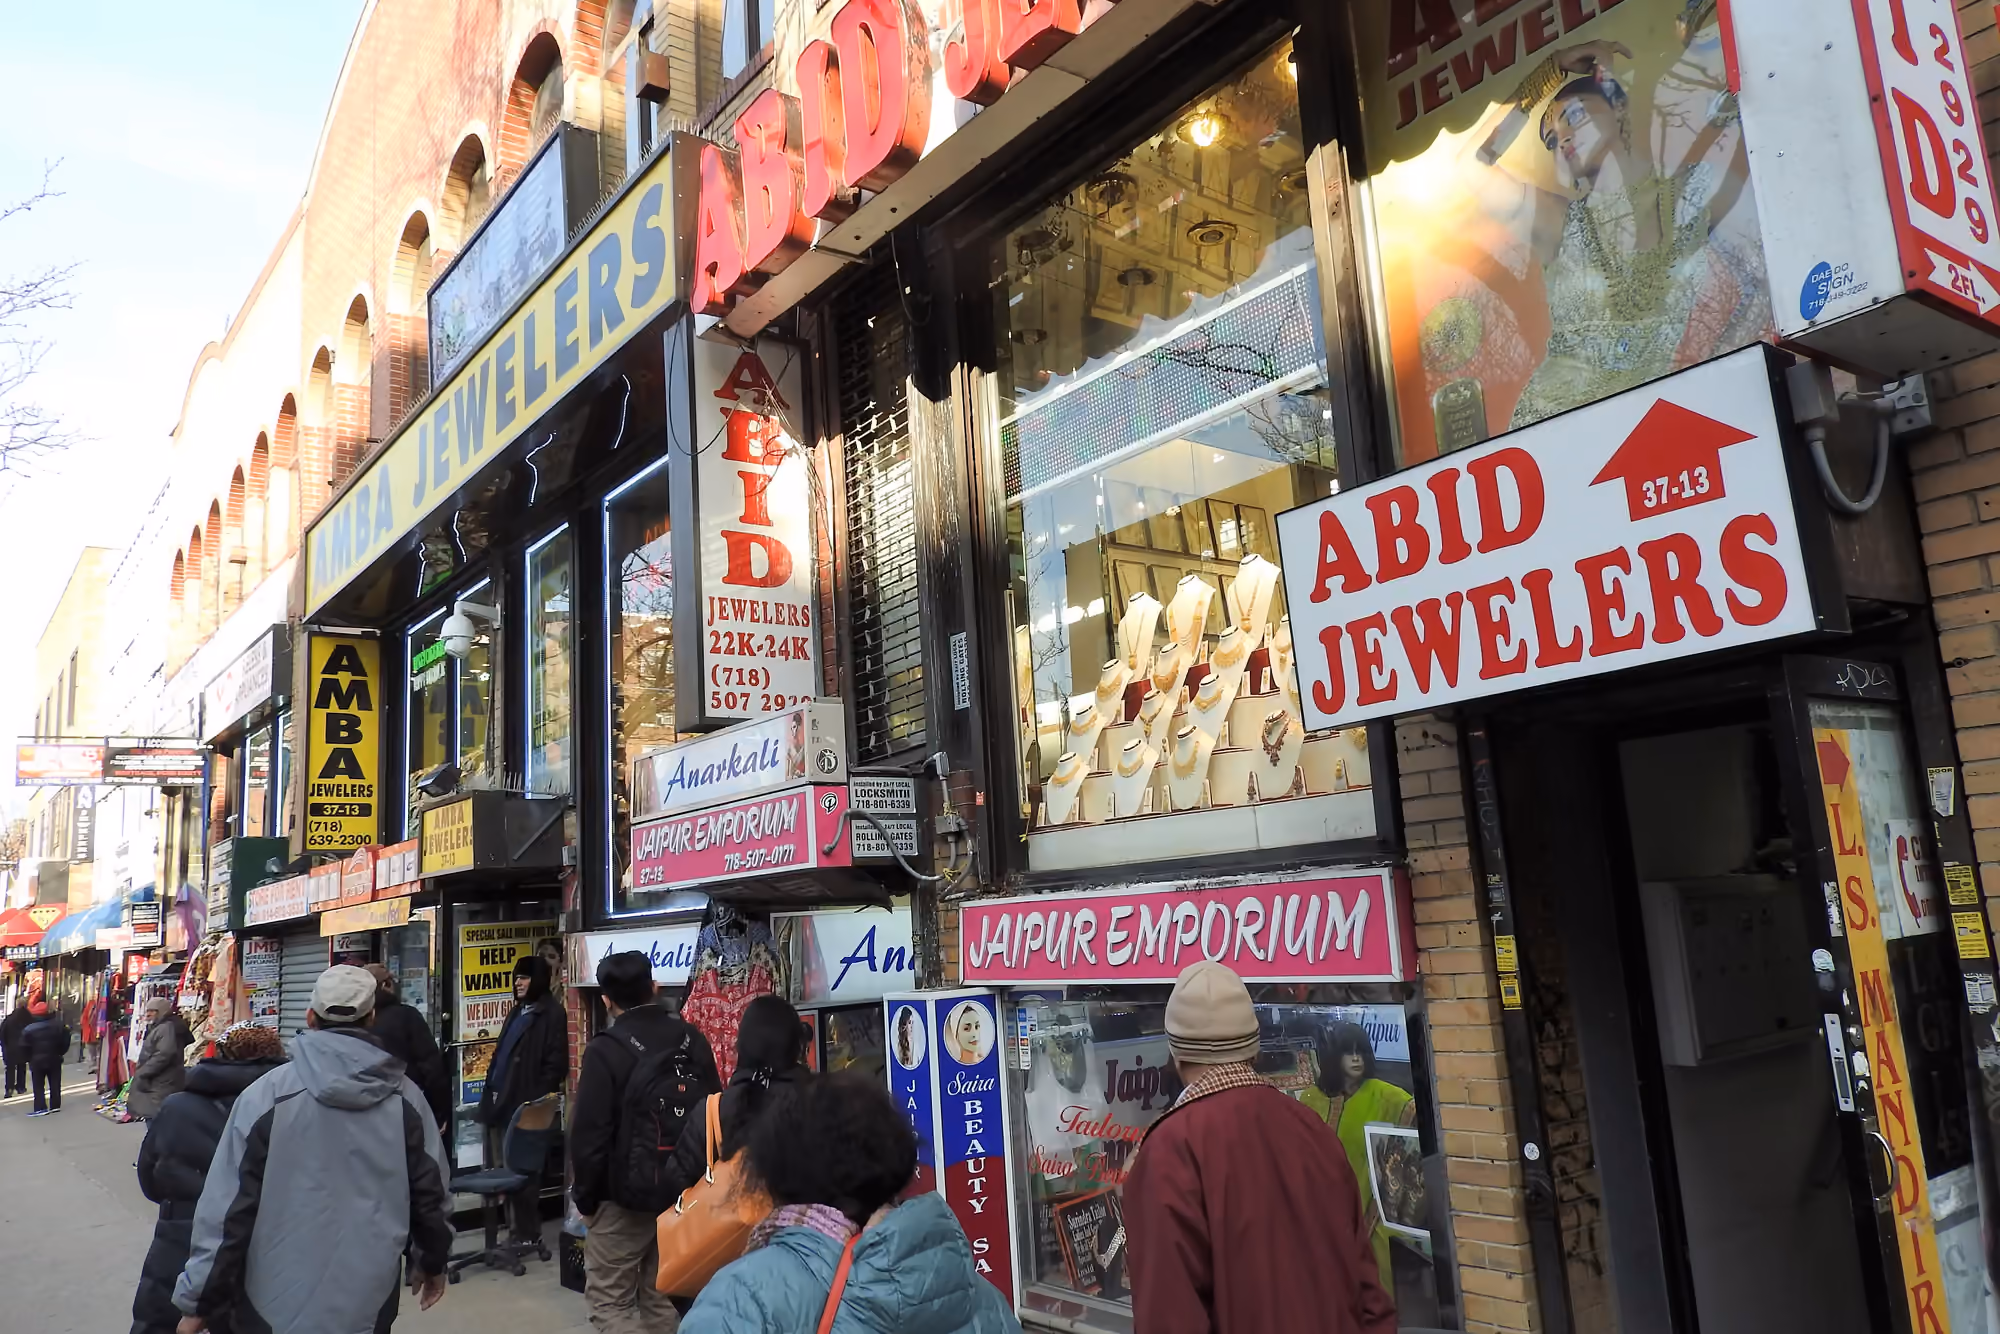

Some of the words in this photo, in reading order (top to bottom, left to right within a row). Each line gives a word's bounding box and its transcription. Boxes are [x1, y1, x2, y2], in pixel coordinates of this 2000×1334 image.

[690, 0, 930, 315] ABID
[1811, 269, 1832, 283] DAE
[1834, 262, 1849, 274] DO
[1817, 271, 1854, 295] SIGN
[312, 462, 394, 600] AMBA
[412, 182, 667, 510] JEWELERS
[713, 351, 791, 588] ABID
[1641, 465, 1710, 509] 37-13
[1310, 446, 1545, 604] ABID
[707, 596, 810, 628] JEWELERS
[1311, 512, 1789, 716] JEWELERS
[709, 630, 810, 661] 22K-24K
[711, 666, 771, 691] (718)
[313, 644, 374, 780] AMBA
[711, 690, 751, 712] 507
[663, 738, 780, 805] Anarkali
[309, 783, 374, 798] JEWELERS
[855, 789, 910, 798] LOCKSMITH
[322, 804, 360, 816] 37-13
[433, 803, 465, 831] AMBA
[856, 799, 911, 809] 718-801-6339
[308, 819, 343, 833] (718)
[636, 820, 693, 863] JAIPUR
[694, 797, 799, 851] EMPORIUM
[856, 832, 886, 841] ROLLIN
[890, 832, 913, 841] GATES
[308, 834, 372, 846] 639-2300
[640, 865, 665, 884] 37-13
[724, 844, 796, 872] 718-507-0177
[968, 907, 1098, 970] JAIPUR
[1105, 888, 1371, 967] EMPORIUM
[480, 947, 516, 966] HELP
[464, 971, 512, 992] WANT
[467, 1003, 481, 1021] WE
[483, 1001, 500, 1020] BUY
[947, 1071, 995, 1096] Saira
[963, 1099, 988, 1214] BEAUTY
